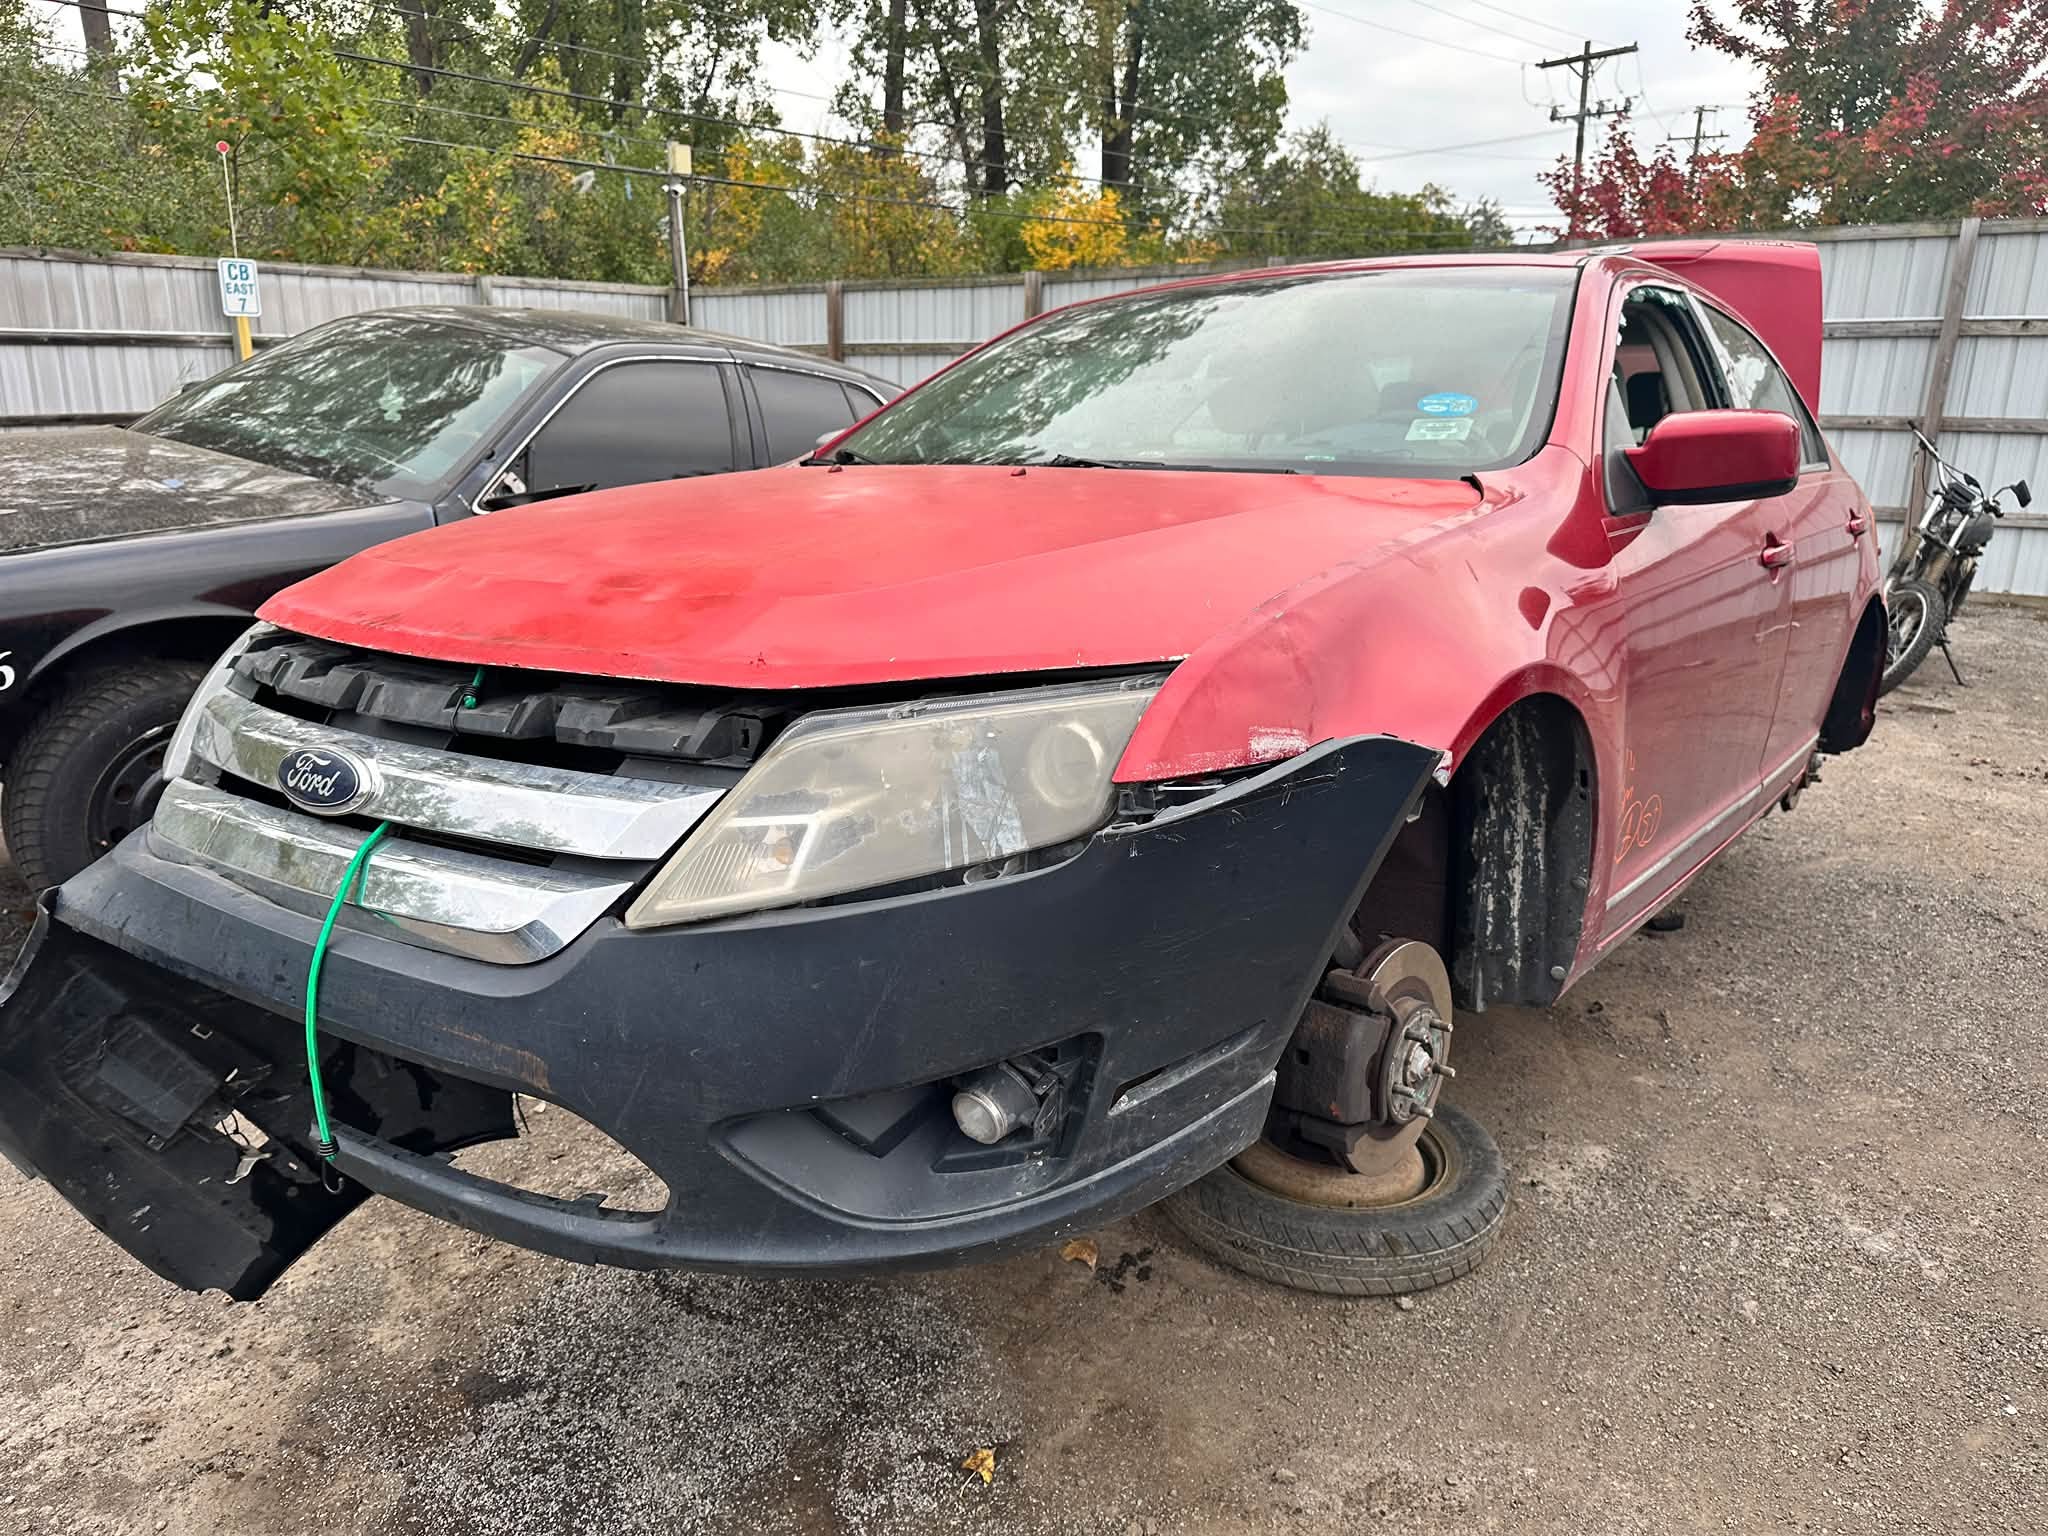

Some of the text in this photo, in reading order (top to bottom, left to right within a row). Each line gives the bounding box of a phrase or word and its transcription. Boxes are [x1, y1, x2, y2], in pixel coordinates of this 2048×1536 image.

[228, 263, 250, 281] CB
[225, 282, 256, 295] EAST
[238, 297, 247, 313] 7
[287, 752, 342, 797] Ford
